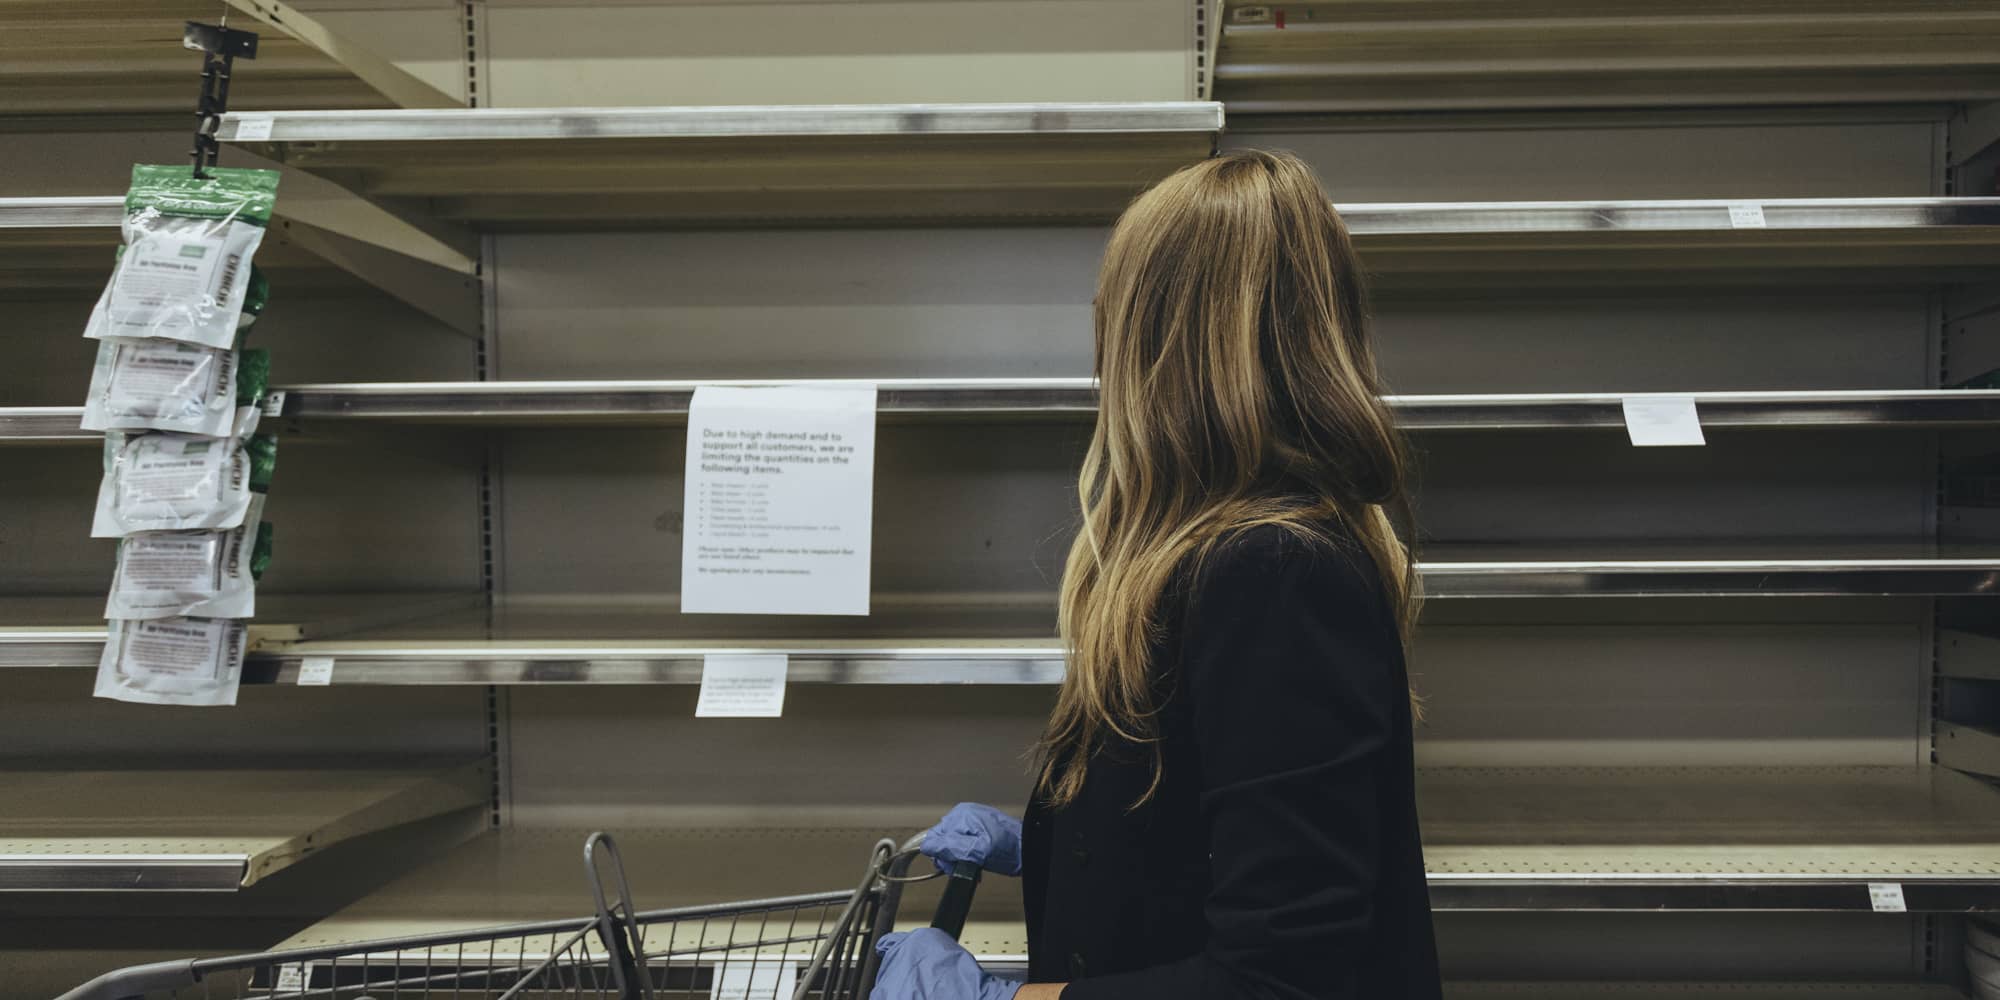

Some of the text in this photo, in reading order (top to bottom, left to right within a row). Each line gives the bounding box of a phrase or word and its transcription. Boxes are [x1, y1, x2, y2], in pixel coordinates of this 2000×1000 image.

[703, 428, 842, 441] Due to high demand and to
[702, 441, 743, 451] support
[746, 442, 758, 450] all
[760, 443, 817, 453] customers,
[701, 452, 741, 463] limiting
[744, 453, 760, 462] the
[763, 454, 814, 465] quantities
[832, 455, 849, 464] the
[701, 463, 784, 475] following items.
